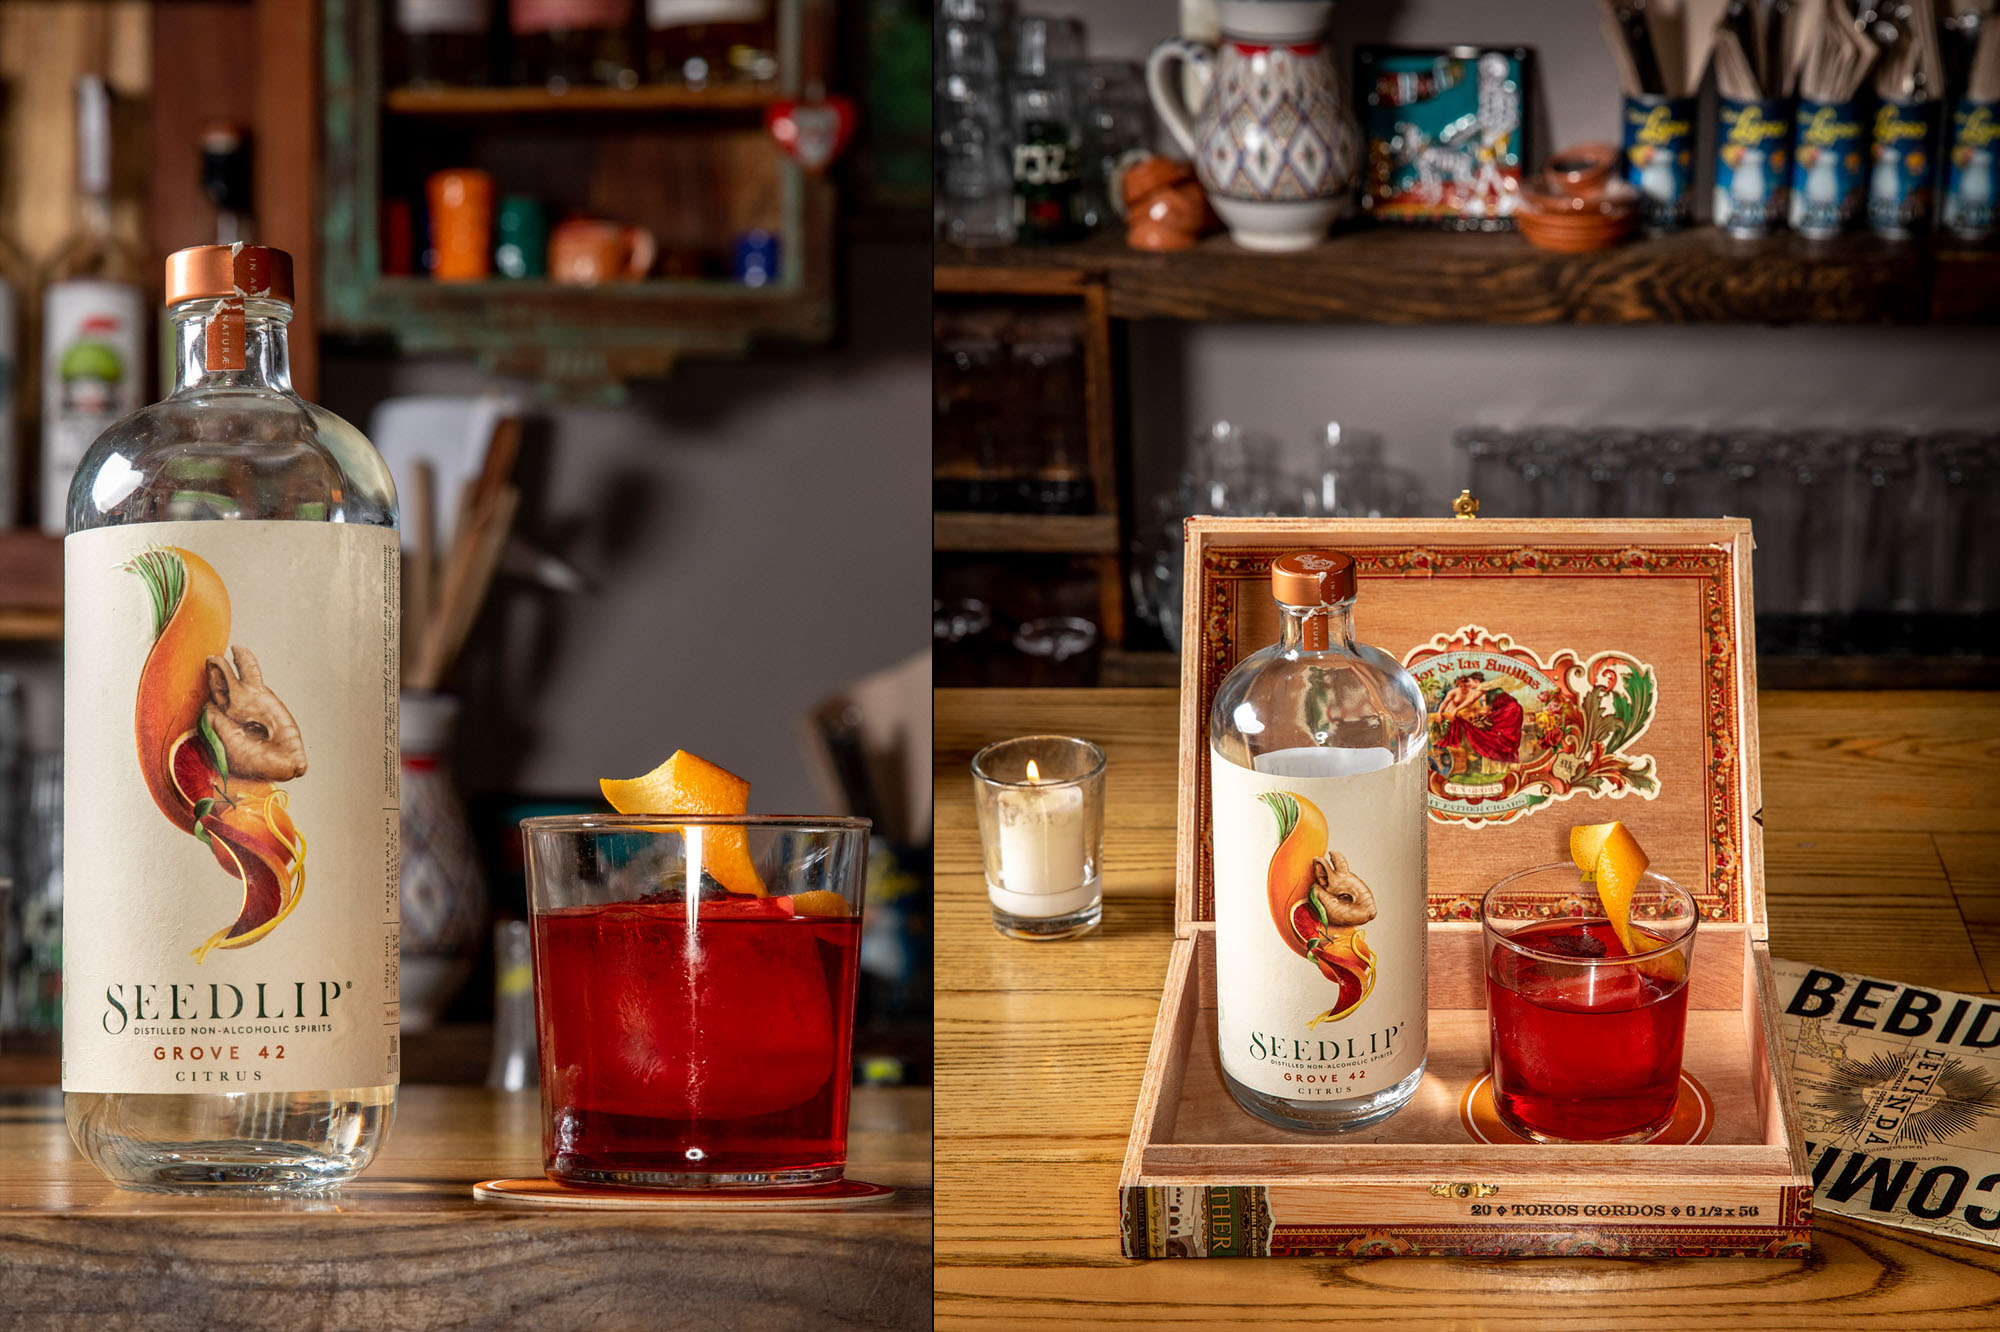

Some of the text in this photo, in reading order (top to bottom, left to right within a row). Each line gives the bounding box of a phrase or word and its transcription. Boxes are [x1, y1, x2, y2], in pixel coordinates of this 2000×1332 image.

[249, 258, 257, 271] IN
[1413, 658, 1541, 690] lor de las Antillas
[134, 1023, 332, 1036] DISTILLED NON-ALCOHOLIC SPIRITS
[153, 1044, 285, 1061] GROVE 42
[1270, 1050, 1394, 1070] DISTILLED NON-ALCOHOLIC SPIRITS
[175, 1070, 263, 1082] CITRUS
[1283, 1070, 1366, 1083] GROVE 42
[1297, 1086, 1352, 1095] CITRUS
[1805, 1142, 2000, 1231] COMI
[1471, 1204, 1759, 1218] 20 TOROS GORDOS 6 1/2 x 56
